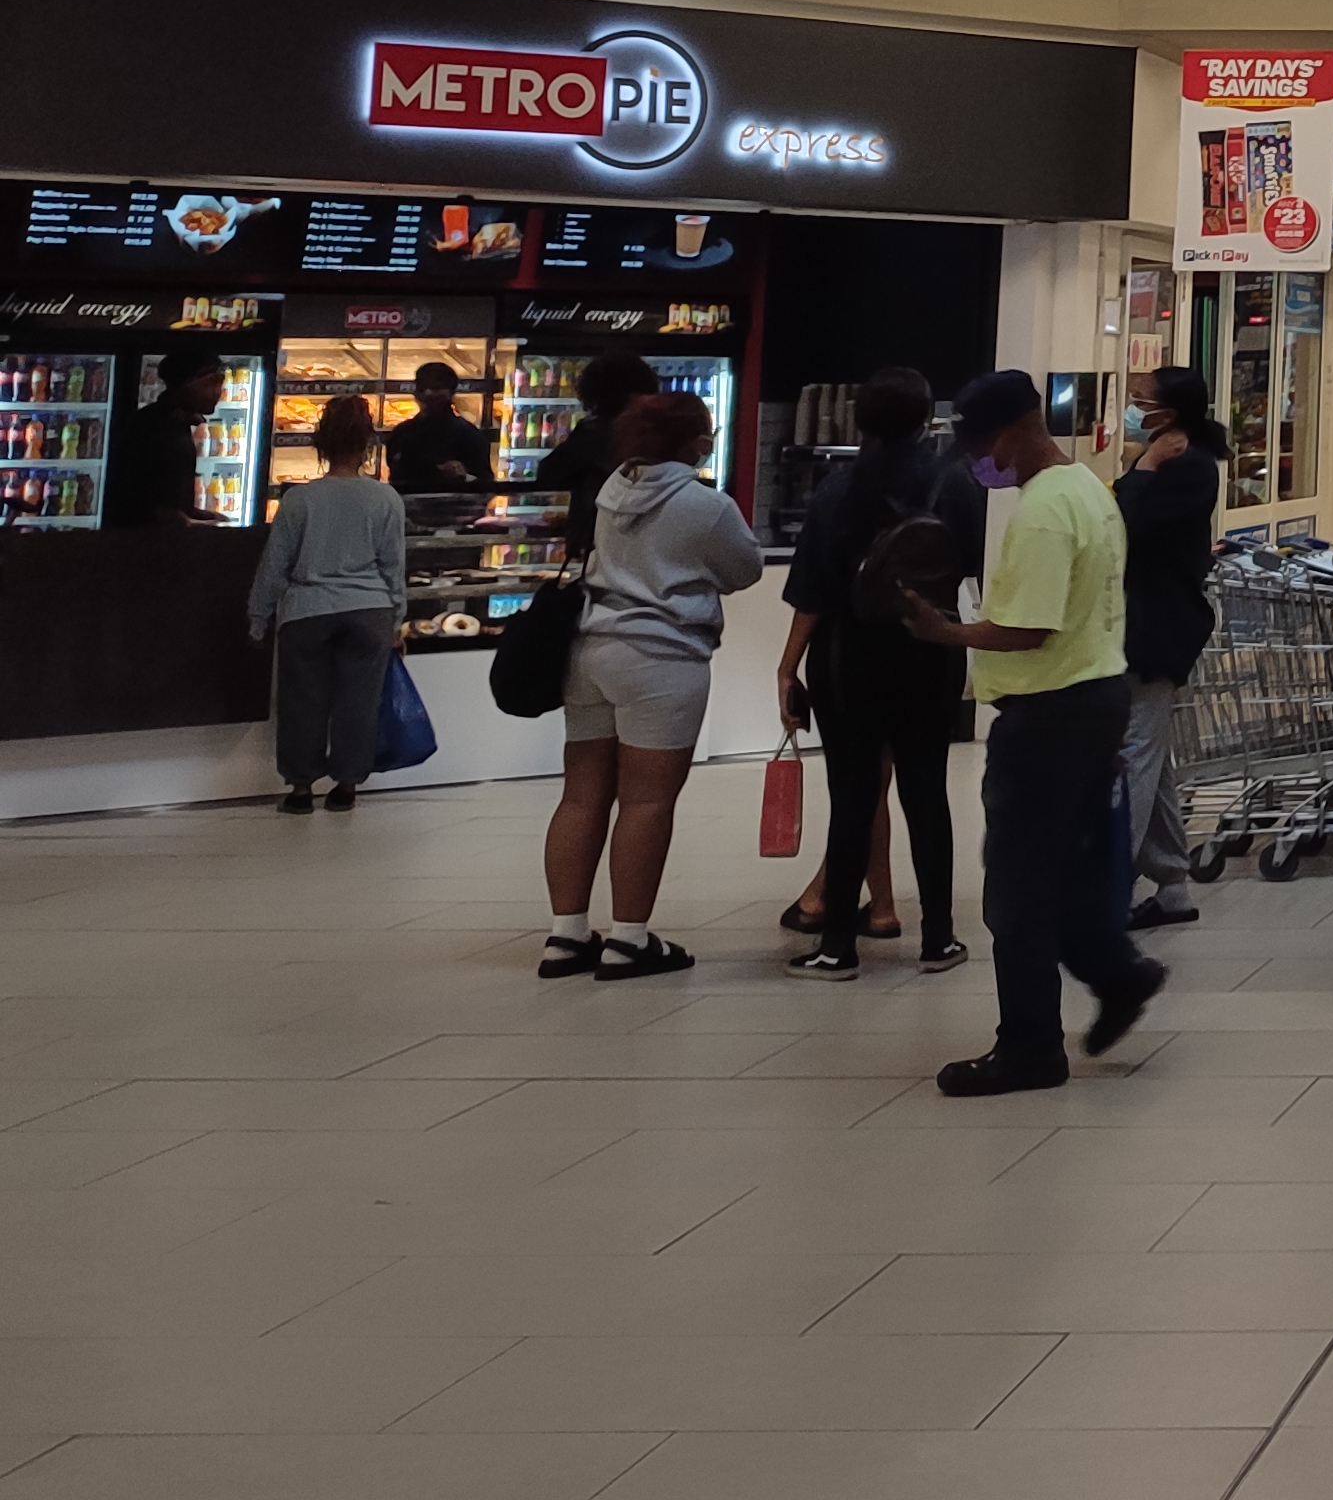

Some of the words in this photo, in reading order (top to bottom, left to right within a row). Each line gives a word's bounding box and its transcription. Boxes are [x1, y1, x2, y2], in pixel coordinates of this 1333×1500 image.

[379, 60, 597, 119] METRO
[1208, 78, 1309, 97] SAVINGS
[738, 119, 885, 169] express
[1296, 198, 1304, 208] 3
[1274, 208, 1306, 225] R23
[1183, 249, 1211, 262] Pick
[1212, 252, 1220, 261] n
[1221, 249, 1250, 264] Pay
[77, 302, 151, 326] energy
[348, 310, 402, 325] METRO
[520, 300, 582, 328] liquid
[584, 308, 645, 330] energy
